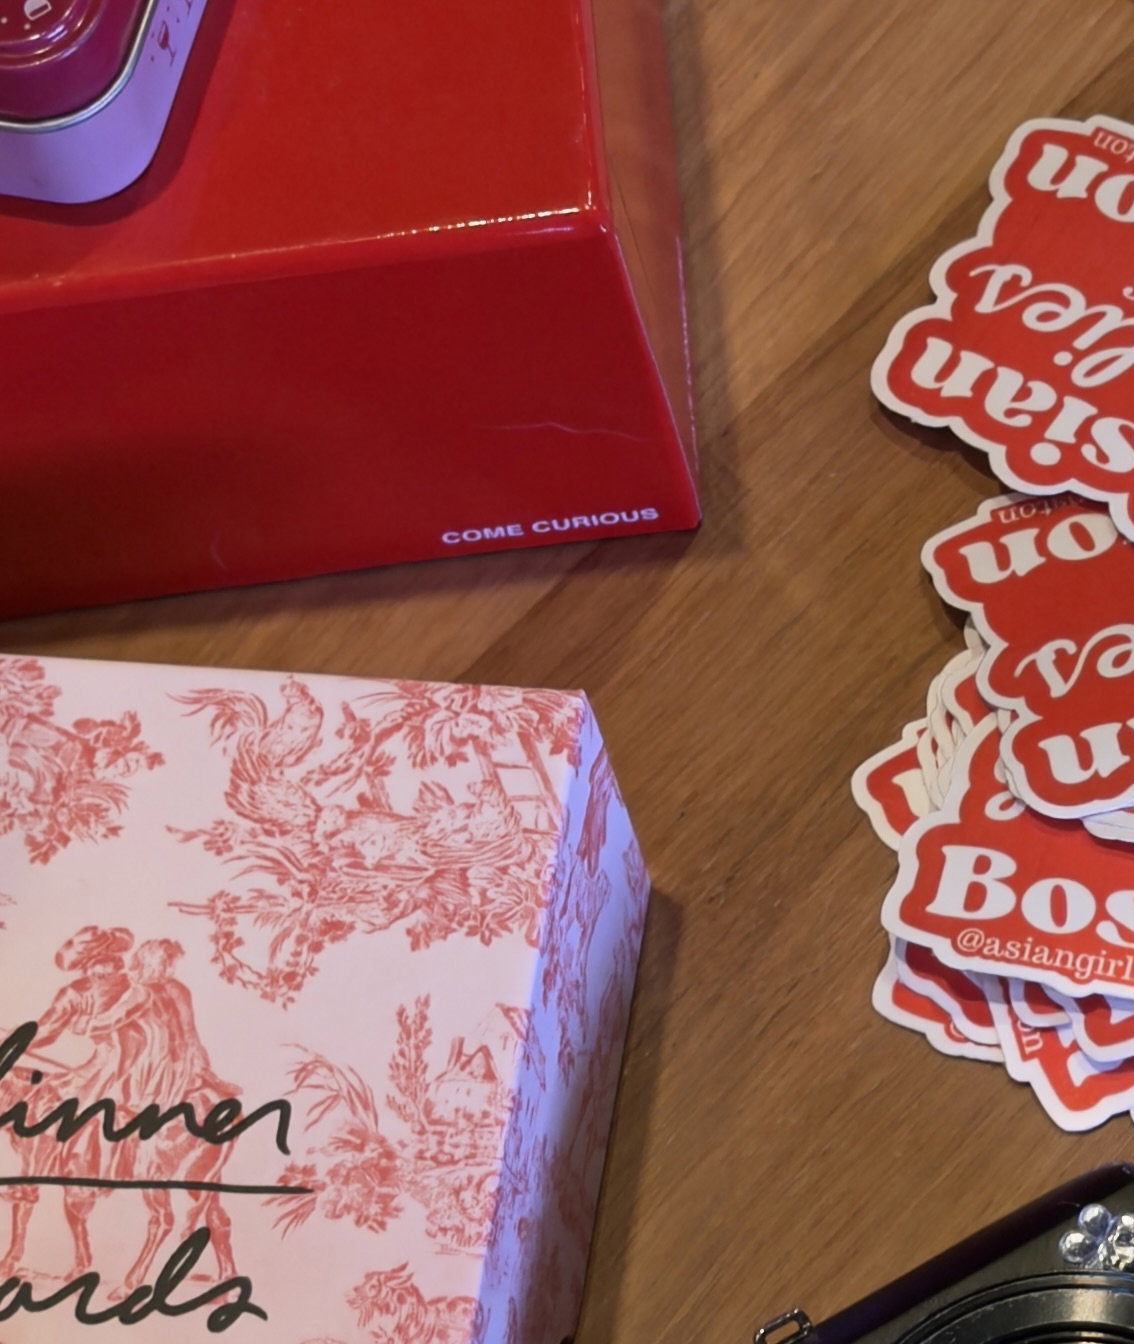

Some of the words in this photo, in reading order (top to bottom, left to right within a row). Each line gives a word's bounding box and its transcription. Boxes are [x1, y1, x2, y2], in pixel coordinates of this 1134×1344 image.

[441, 524, 524, 544] COME
[531, 507, 660, 533] CURIOUS
[0, 1227, 268, 1333] ards
